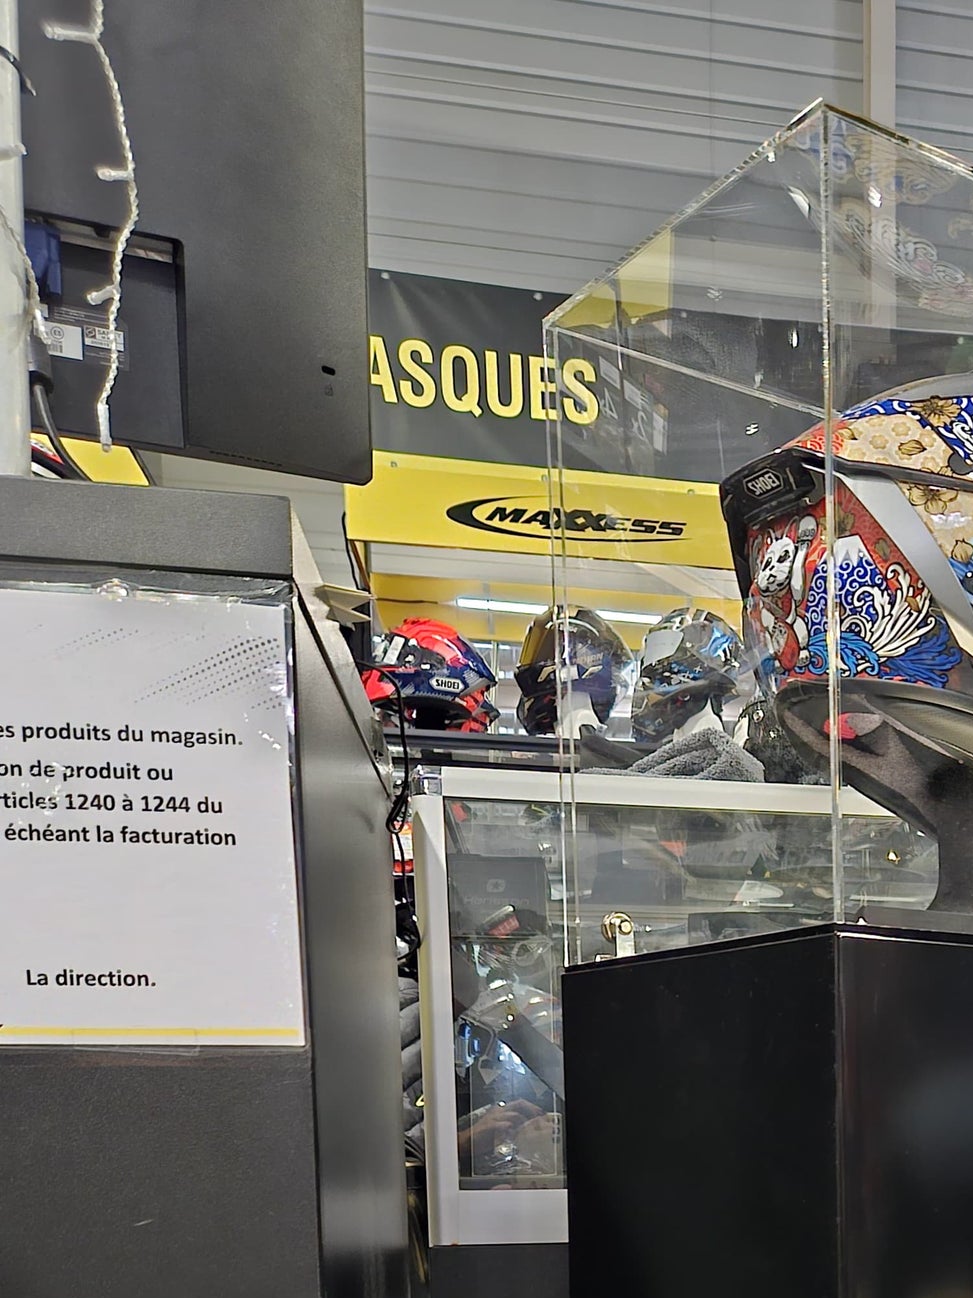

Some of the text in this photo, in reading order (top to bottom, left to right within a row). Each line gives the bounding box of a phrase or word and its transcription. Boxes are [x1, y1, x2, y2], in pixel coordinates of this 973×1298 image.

[369, 334, 601, 425] ASQUES
[747, 472, 780, 495] SHOEI
[485, 506, 688, 536] MAXXESS
[435, 679, 460, 690] SHOEI
[22, 722, 111, 742] produits
[118, 724, 143, 742] du
[151, 728, 243, 748] magasin.
[29, 759, 55, 777] de
[62, 761, 141, 781] produit
[147, 767, 173, 780] ou
[0, 791, 223, 813] ticles 1240 à 1244 du
[4, 822, 236, 846] échéant la facturation
[25, 968, 157, 988] La direction.
